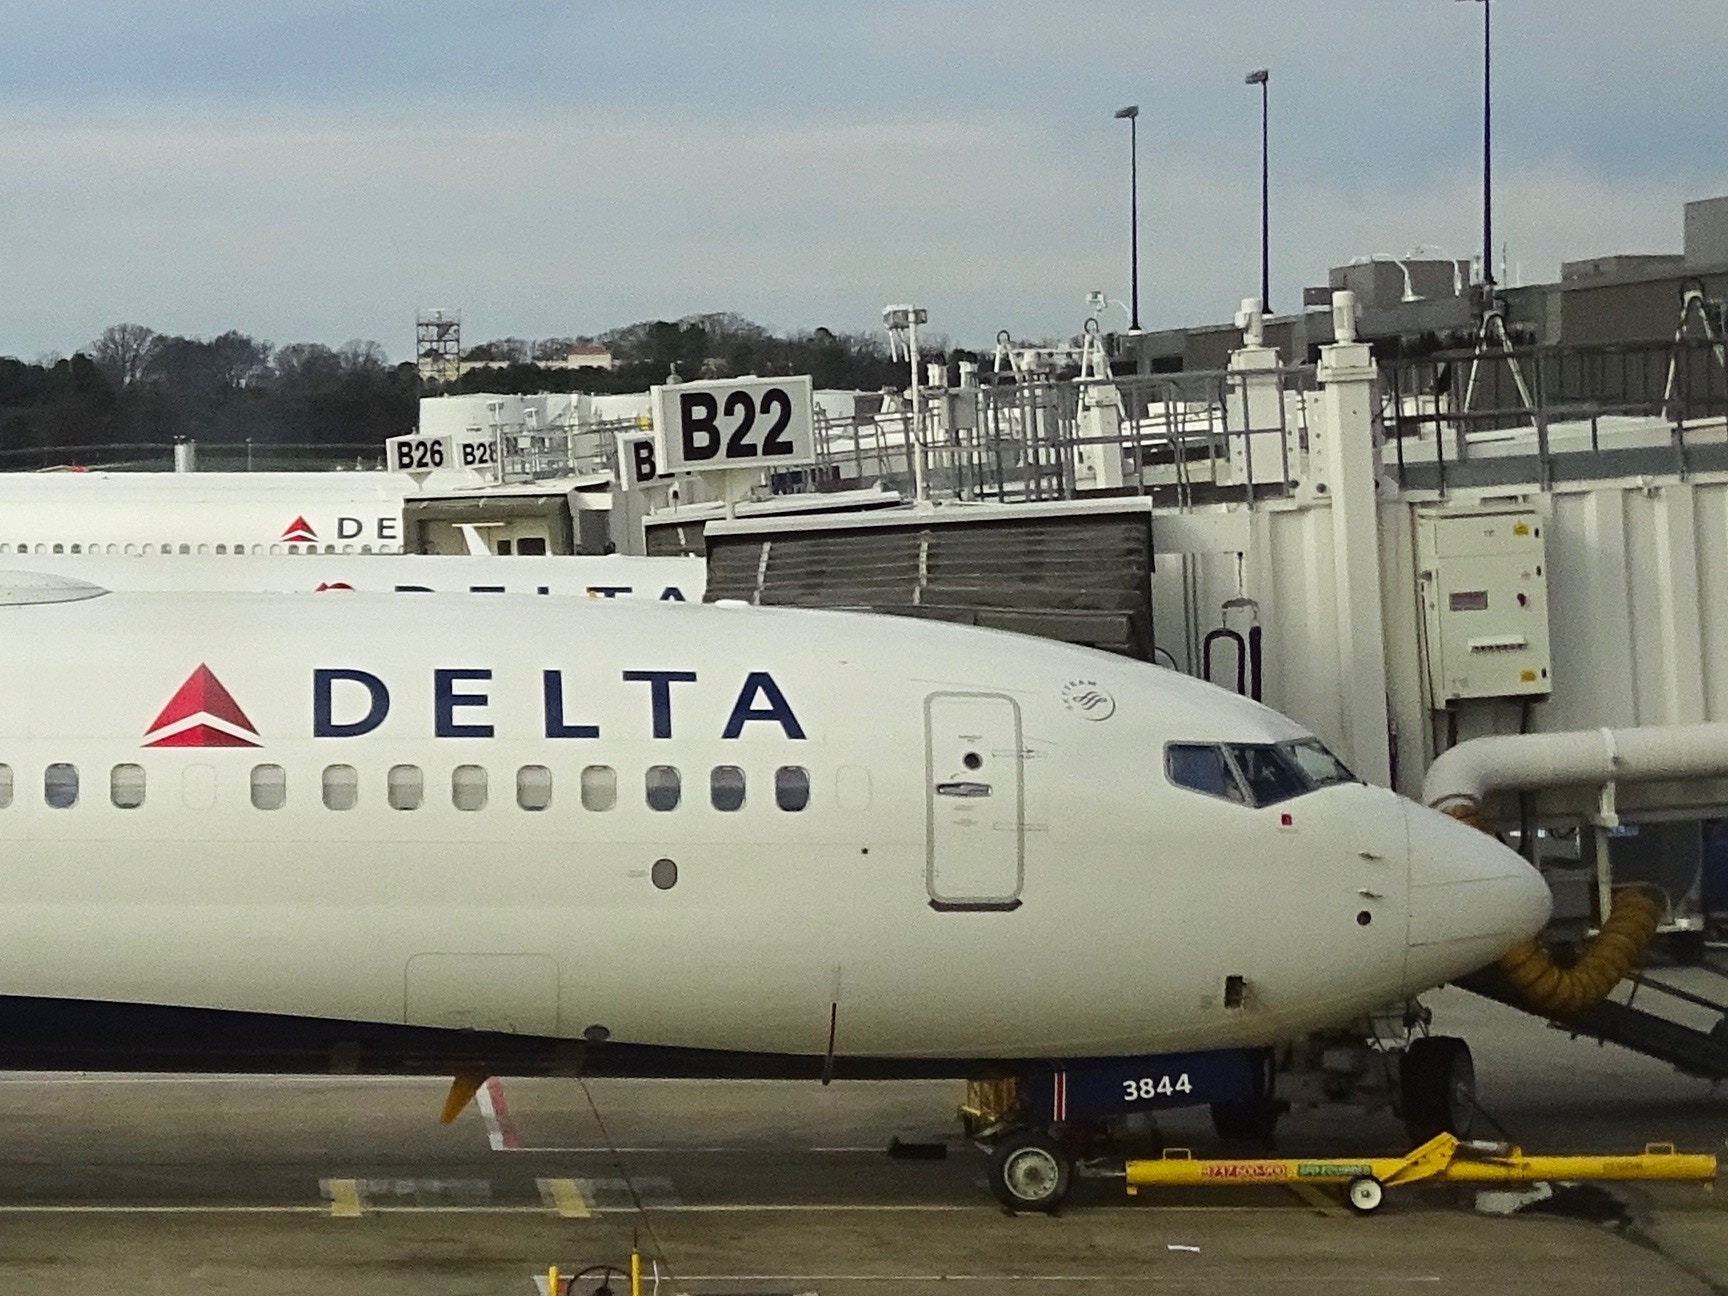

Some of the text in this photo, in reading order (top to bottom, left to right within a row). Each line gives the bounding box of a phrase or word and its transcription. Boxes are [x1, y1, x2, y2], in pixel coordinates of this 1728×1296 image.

[680, 388, 794, 461] B22
[397, 440, 444, 469] B26
[313, 668, 808, 740] DELTA
[1122, 1073, 1193, 1101] 3844
